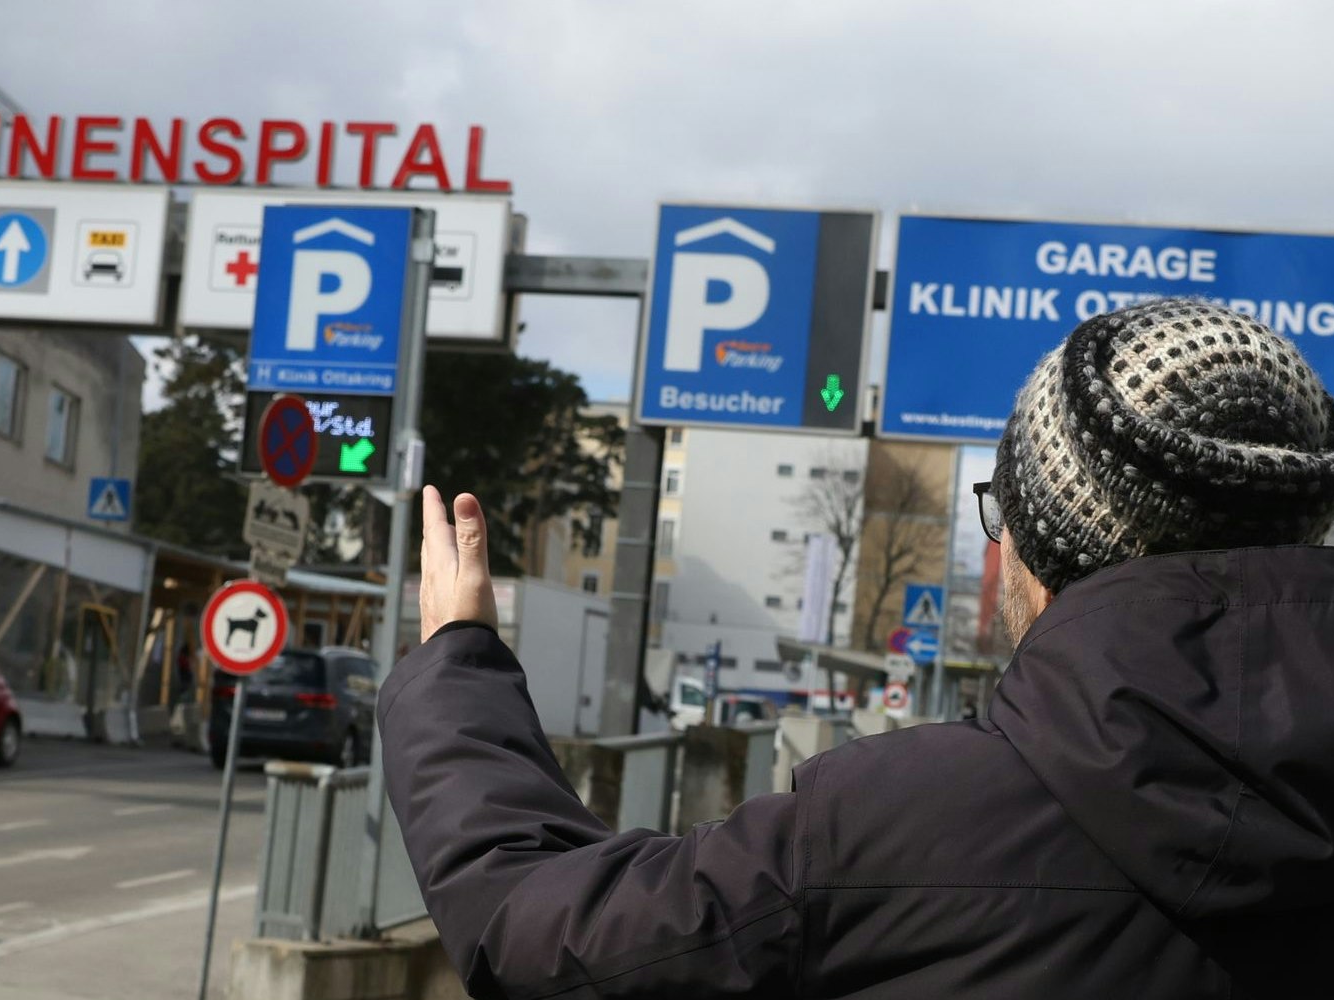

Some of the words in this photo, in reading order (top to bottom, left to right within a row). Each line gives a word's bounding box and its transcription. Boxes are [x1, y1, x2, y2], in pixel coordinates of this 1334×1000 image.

[1035, 240, 1218, 283] GARAGE
[284, 248, 373, 351] P
[662, 252, 771, 373] P
[908, 281, 1061, 322] KLINIK
[278, 369, 317, 383] Klinik
[322, 370, 393, 390] Ottakring
[659, 385, 786, 415] Besucher
